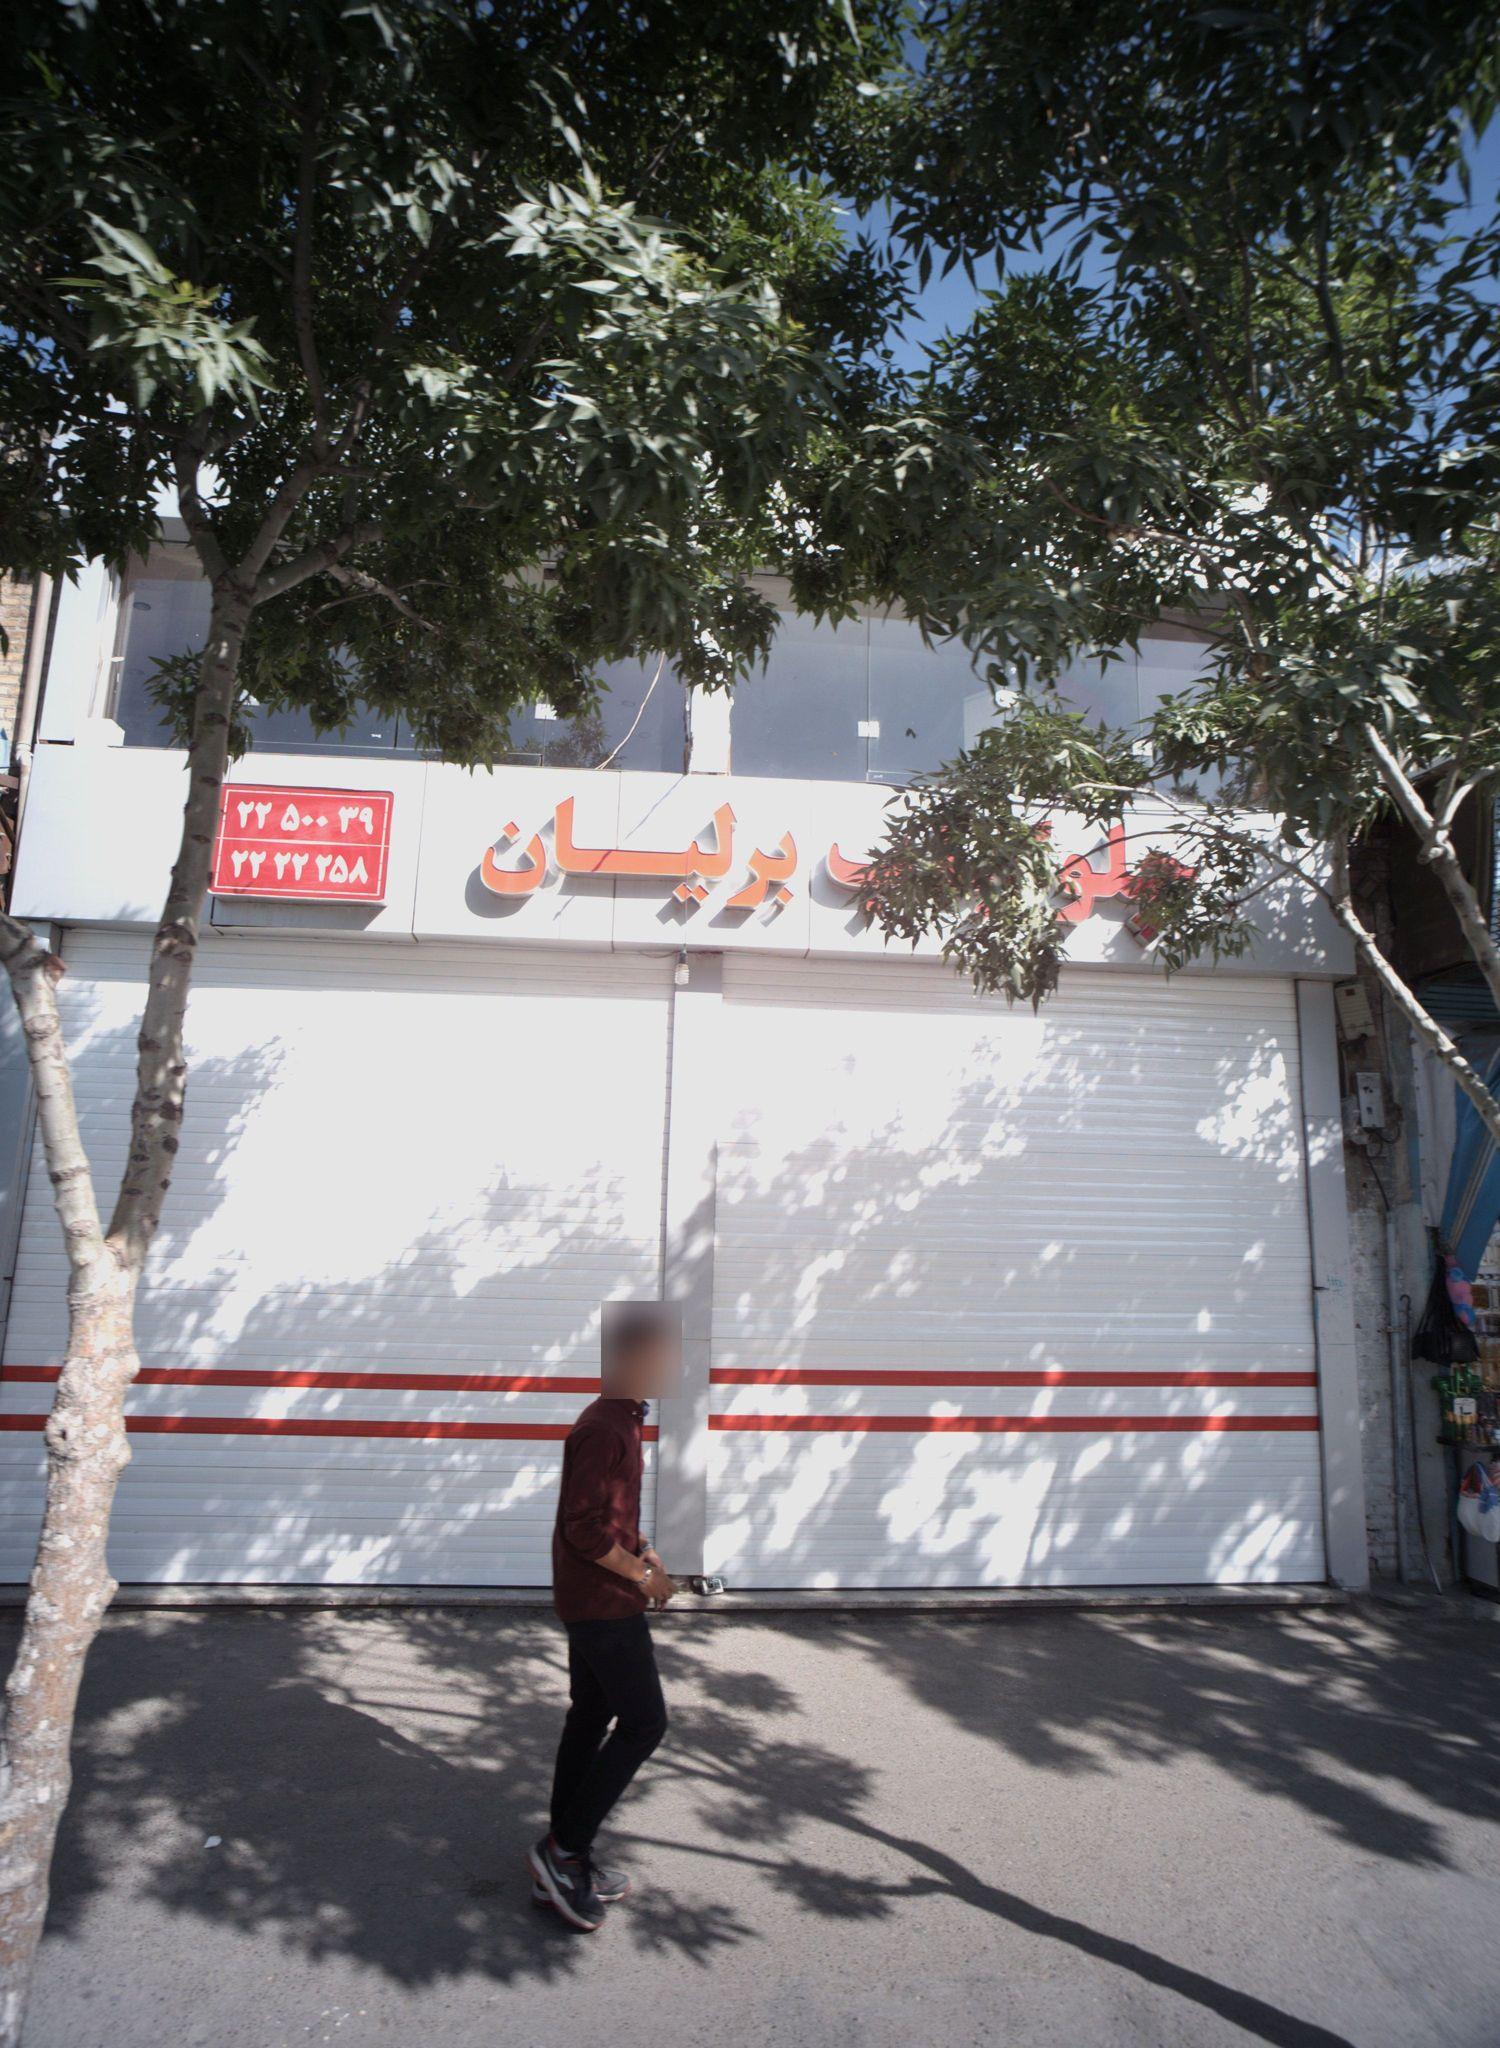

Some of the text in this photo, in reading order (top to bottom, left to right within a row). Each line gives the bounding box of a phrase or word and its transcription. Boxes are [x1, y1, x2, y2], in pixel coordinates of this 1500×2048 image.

[236, 801, 374, 835] ۲۲ ۵۰۰ ۳۹
[230, 850, 369, 884] ۲۲ ۲۲ ۲۵۸
[480, 796, 798, 908] برلیان
